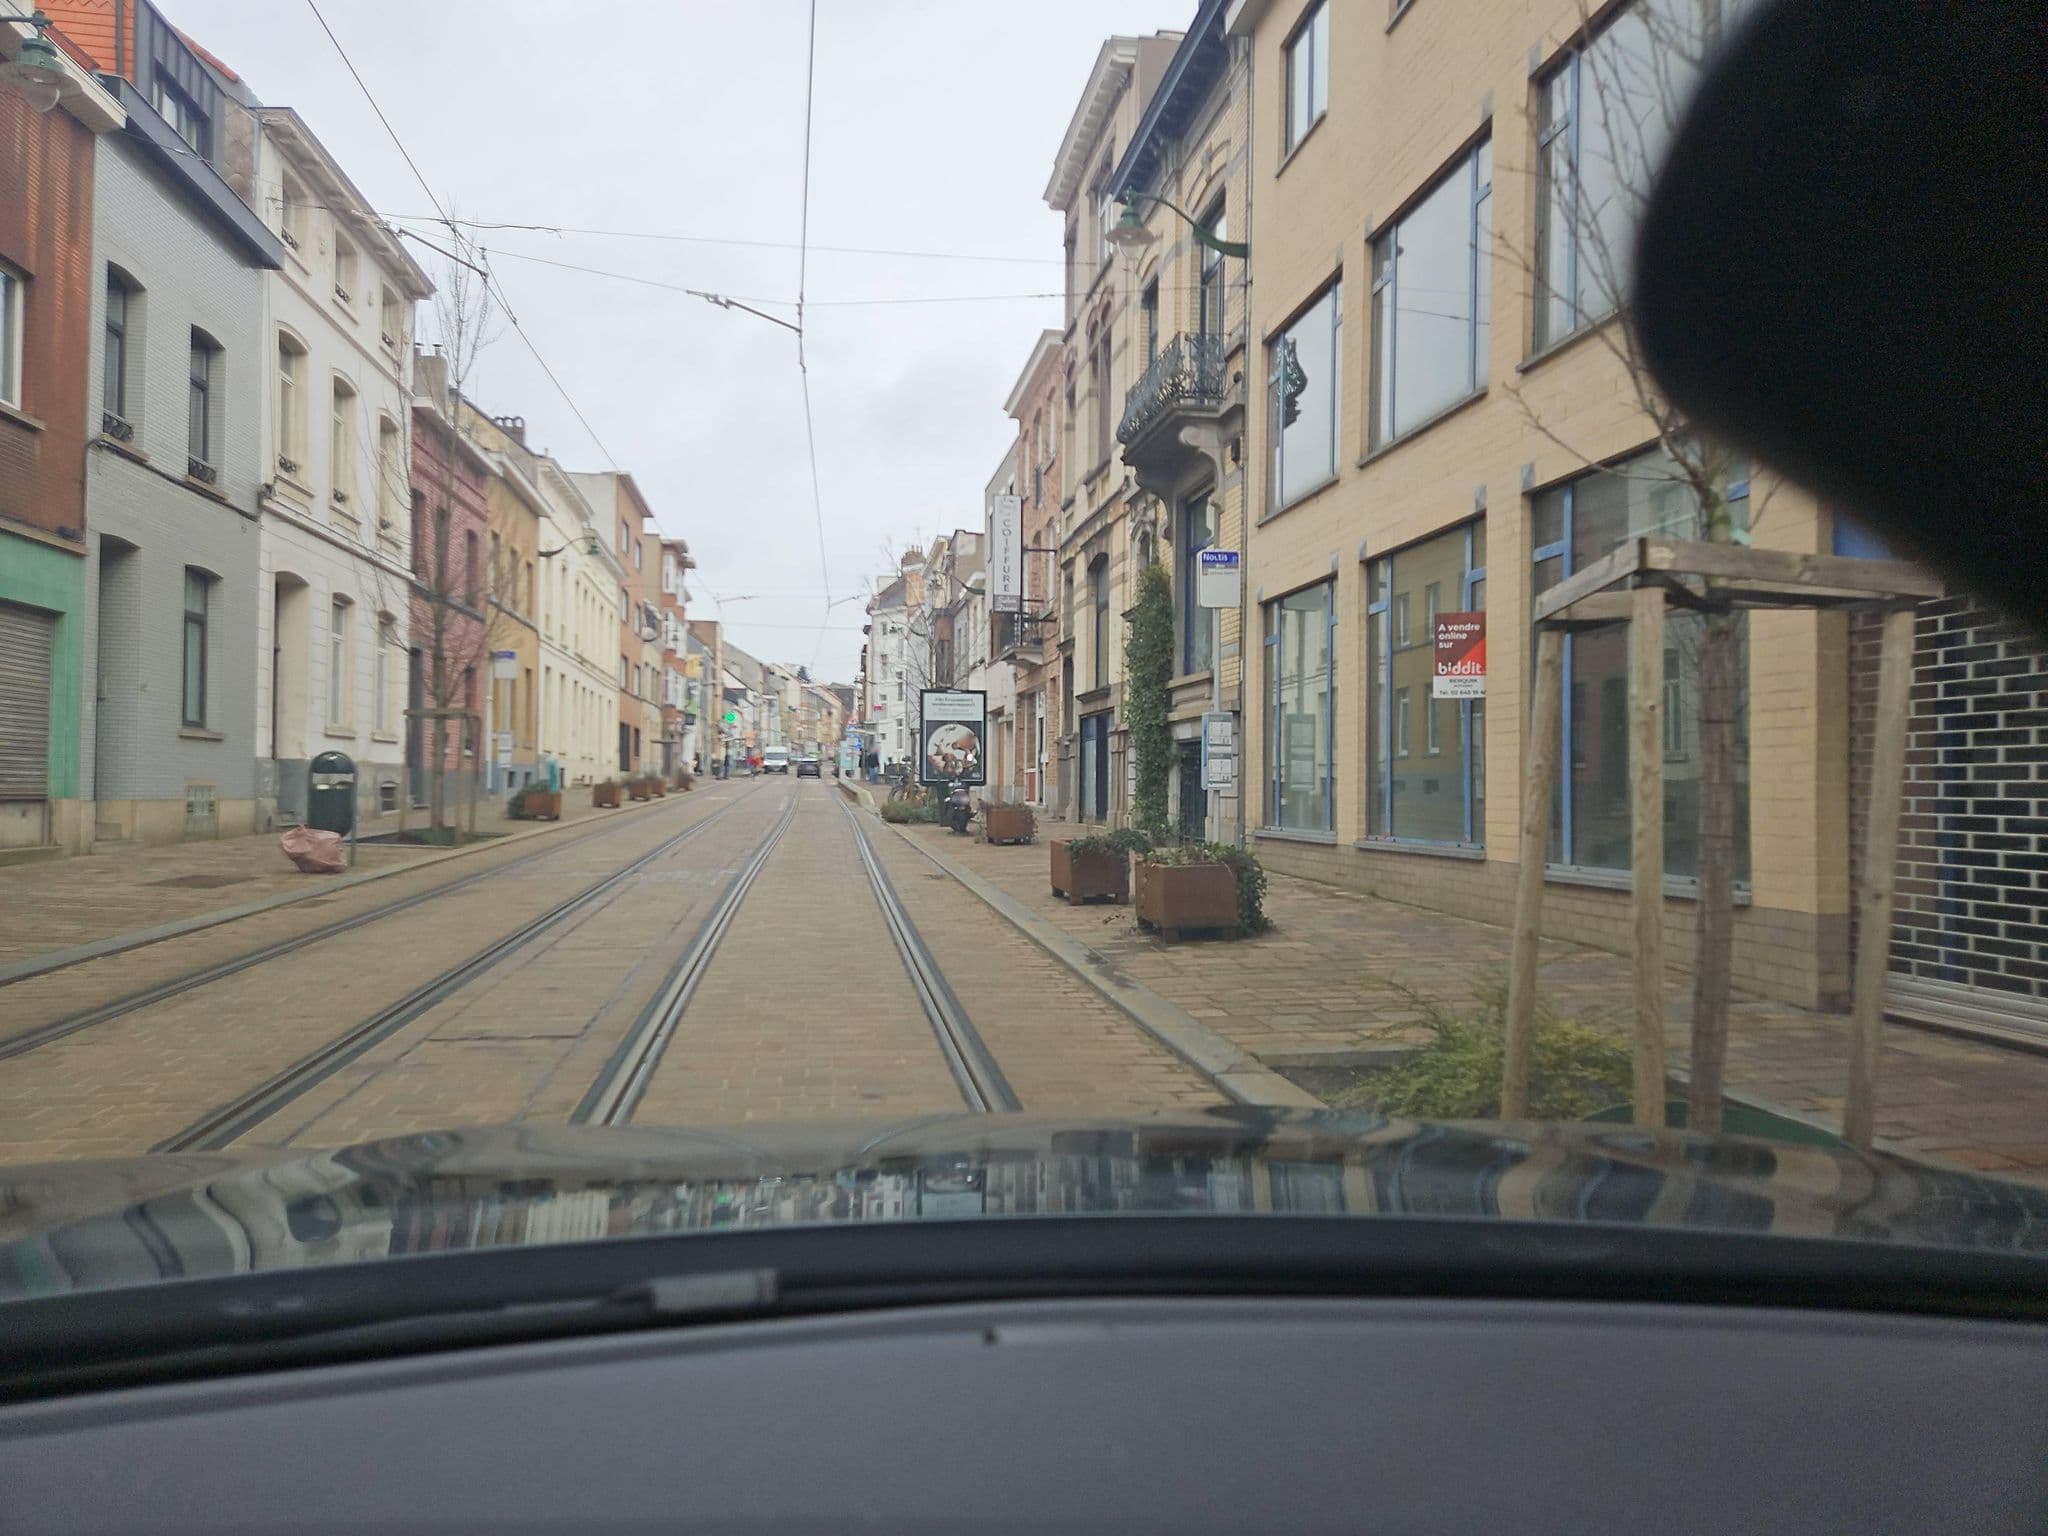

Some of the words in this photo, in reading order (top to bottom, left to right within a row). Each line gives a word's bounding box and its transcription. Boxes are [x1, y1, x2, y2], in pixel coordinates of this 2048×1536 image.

[1002, 520, 1012, 593] COIFFURE
[1448, 623, 1480, 631] vendre
[1438, 631, 1468, 640] online
[1438, 641, 1454, 649] sur
